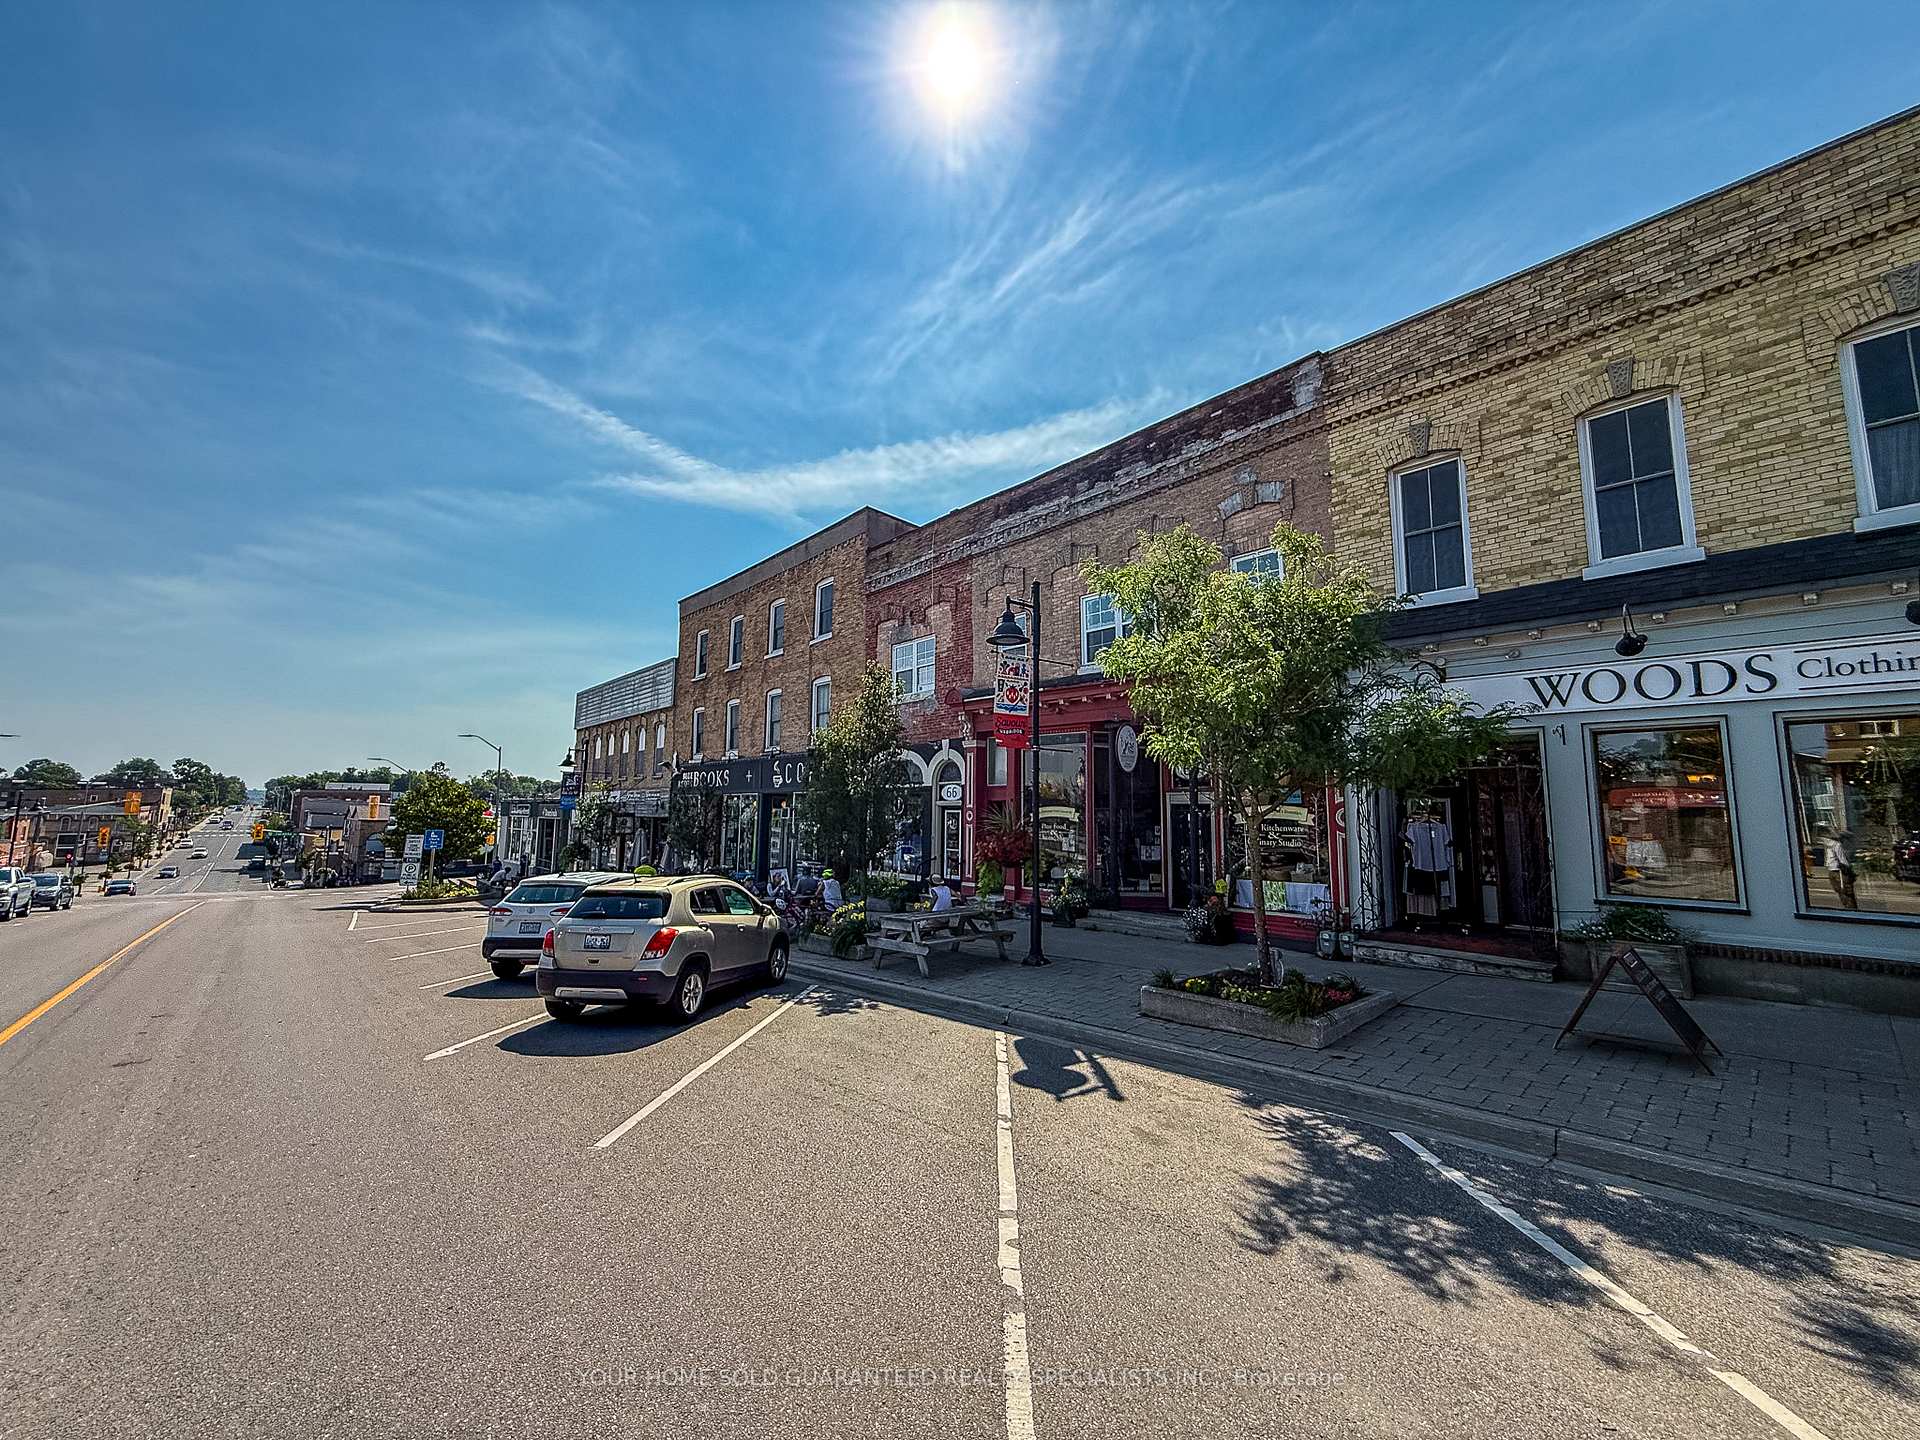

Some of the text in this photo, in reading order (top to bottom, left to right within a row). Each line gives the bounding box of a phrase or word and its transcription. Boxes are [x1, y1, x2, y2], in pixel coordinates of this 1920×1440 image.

[1524, 654, 1777, 708] WOODS
[693, 769, 730, 787] BOOKS
[946, 786, 958, 798] 66
[1261, 823, 1304, 832] Kitchenware
[1267, 831, 1281, 840] &
[1278, 838, 1302, 848] Studio
